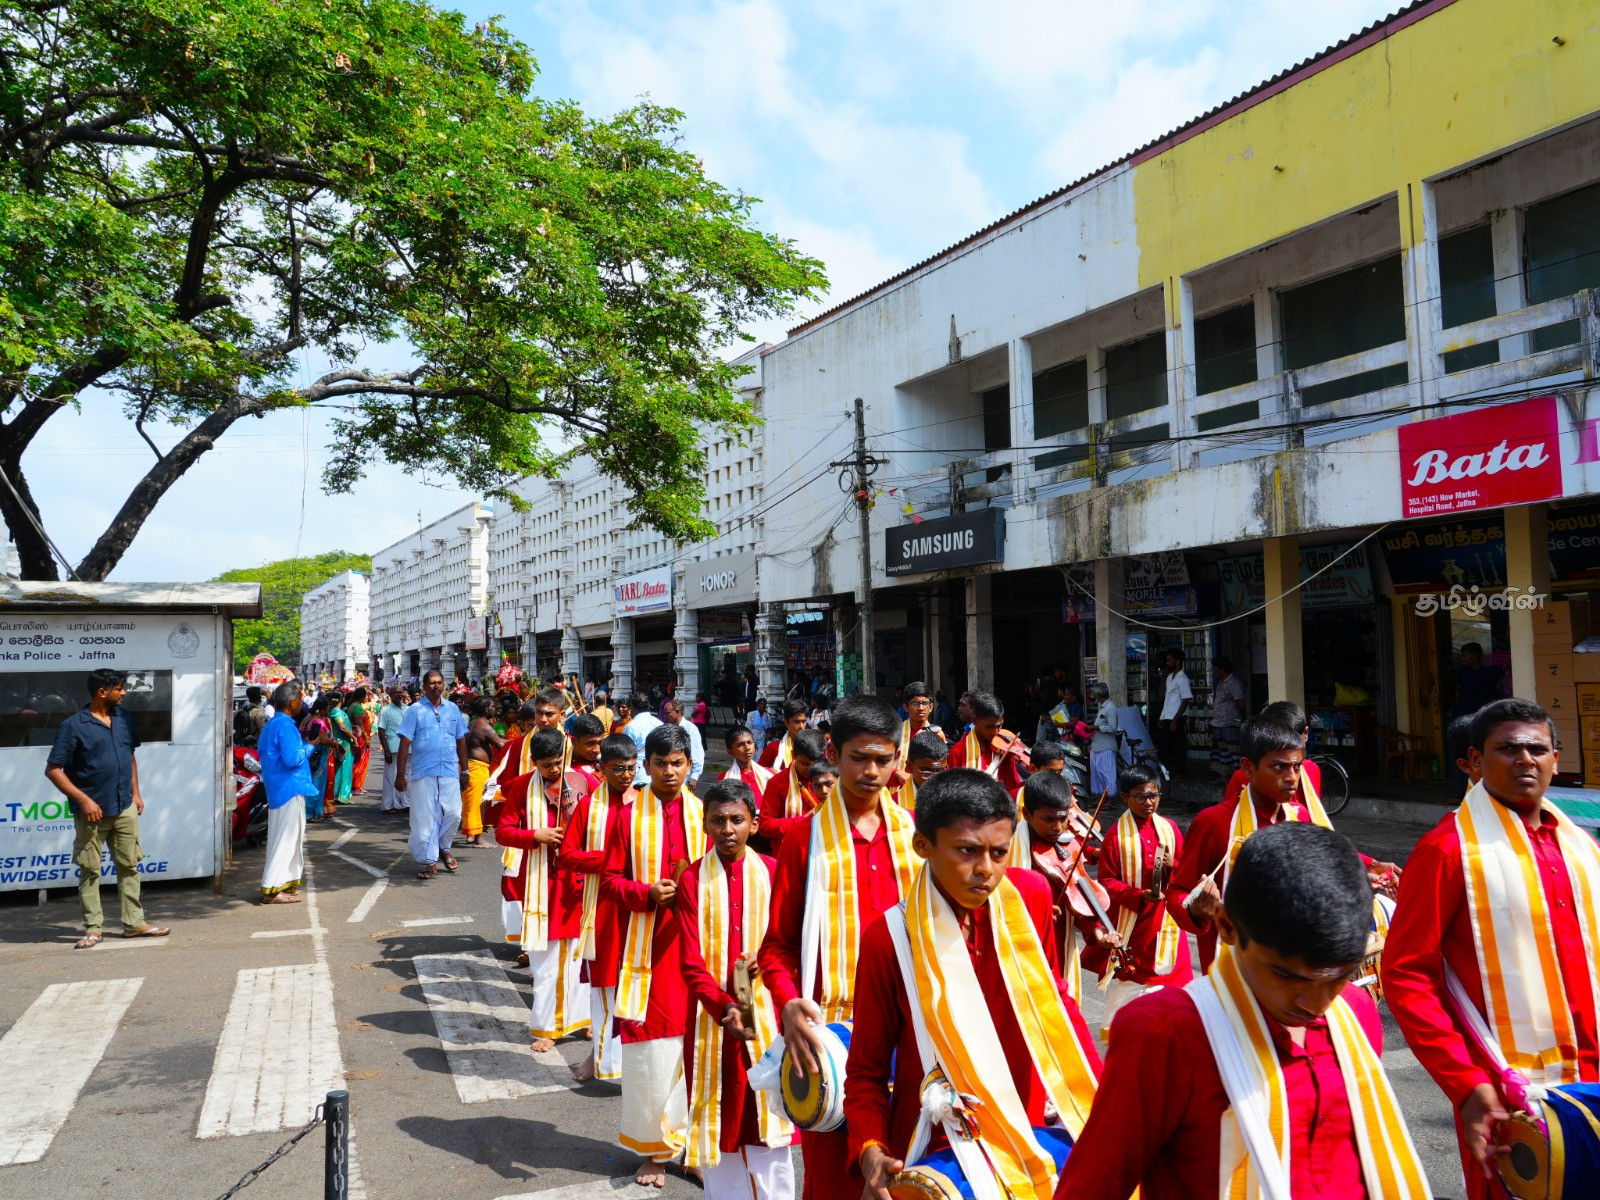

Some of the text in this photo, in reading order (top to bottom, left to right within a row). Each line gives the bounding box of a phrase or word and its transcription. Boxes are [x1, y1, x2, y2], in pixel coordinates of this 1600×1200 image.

[1407, 440, 1549, 487] Bata
[1440, 493, 1454, 502] New
[1409, 505, 1434, 514] Hospital
[1456, 500, 1477, 508] Jaffna
[902, 529, 974, 559] SAMSUNG
[700, 570, 736, 592] HONOR
[1125, 576, 1150, 588] SUNG
[620, 581, 667, 602] YARL Bata
[24, 651, 61, 661] Police
[79, 651, 116, 660] Jaffna
[12, 823, 77, 834] The Conne
[0, 868, 71, 884] WIDEST
